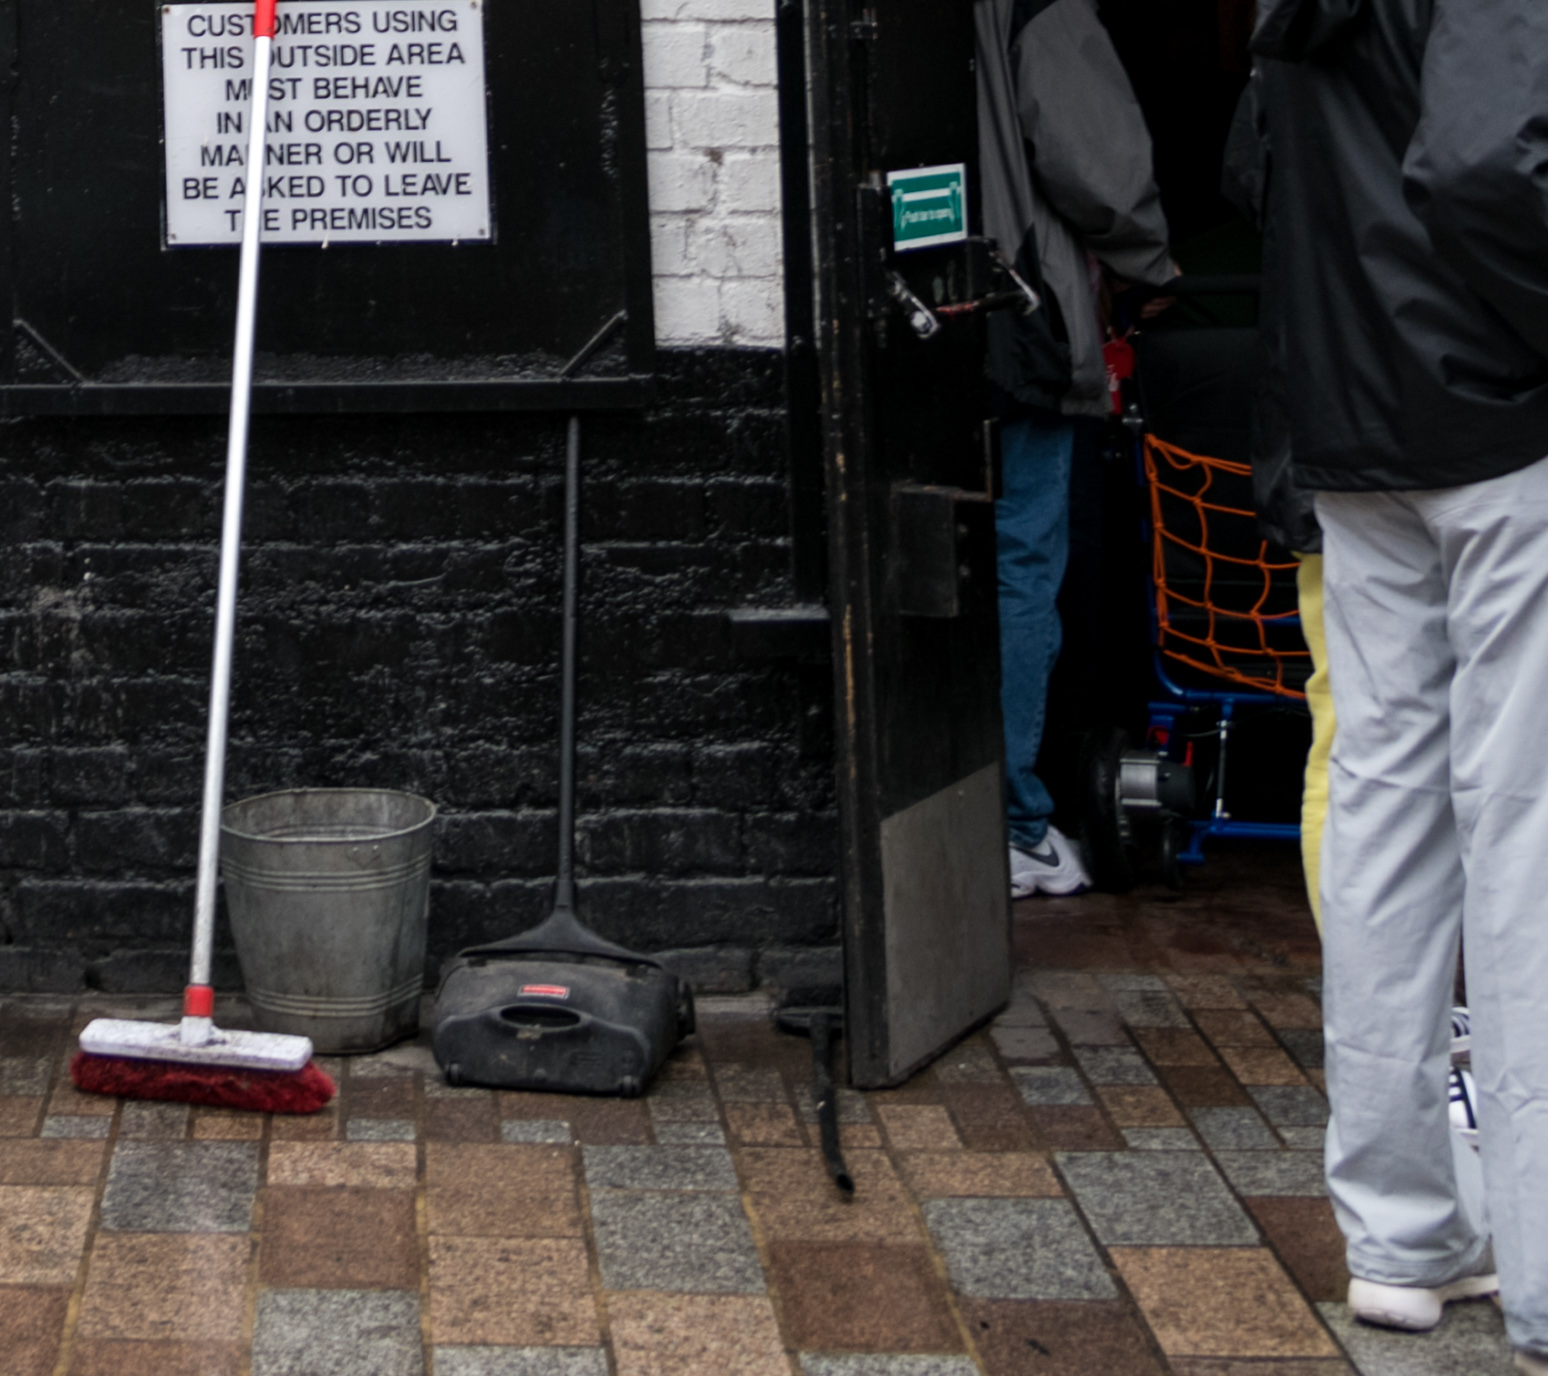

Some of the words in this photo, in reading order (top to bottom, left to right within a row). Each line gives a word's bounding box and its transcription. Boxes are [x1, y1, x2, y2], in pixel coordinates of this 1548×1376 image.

[372, 10, 458, 33] USING
[181, 47, 244, 69] THIS
[268, 44, 375, 68] UTSIDE
[385, 43, 465, 66] AREA
[313, 76, 423, 99] BEHAVE
[217, 112, 242, 134] IN
[305, 108, 432, 133] ORDERLY
[201, 143, 322, 166] MANER
[334, 142, 374, 165] OR
[384, 141, 451, 163] WILL
[183, 178, 218, 199] BE
[229, 175, 324, 199] AKED
[335, 175, 372, 197] TO
[384, 173, 472, 196] LEAVE
[225, 209, 280, 232] TE
[291, 206, 432, 231] PREMISES
